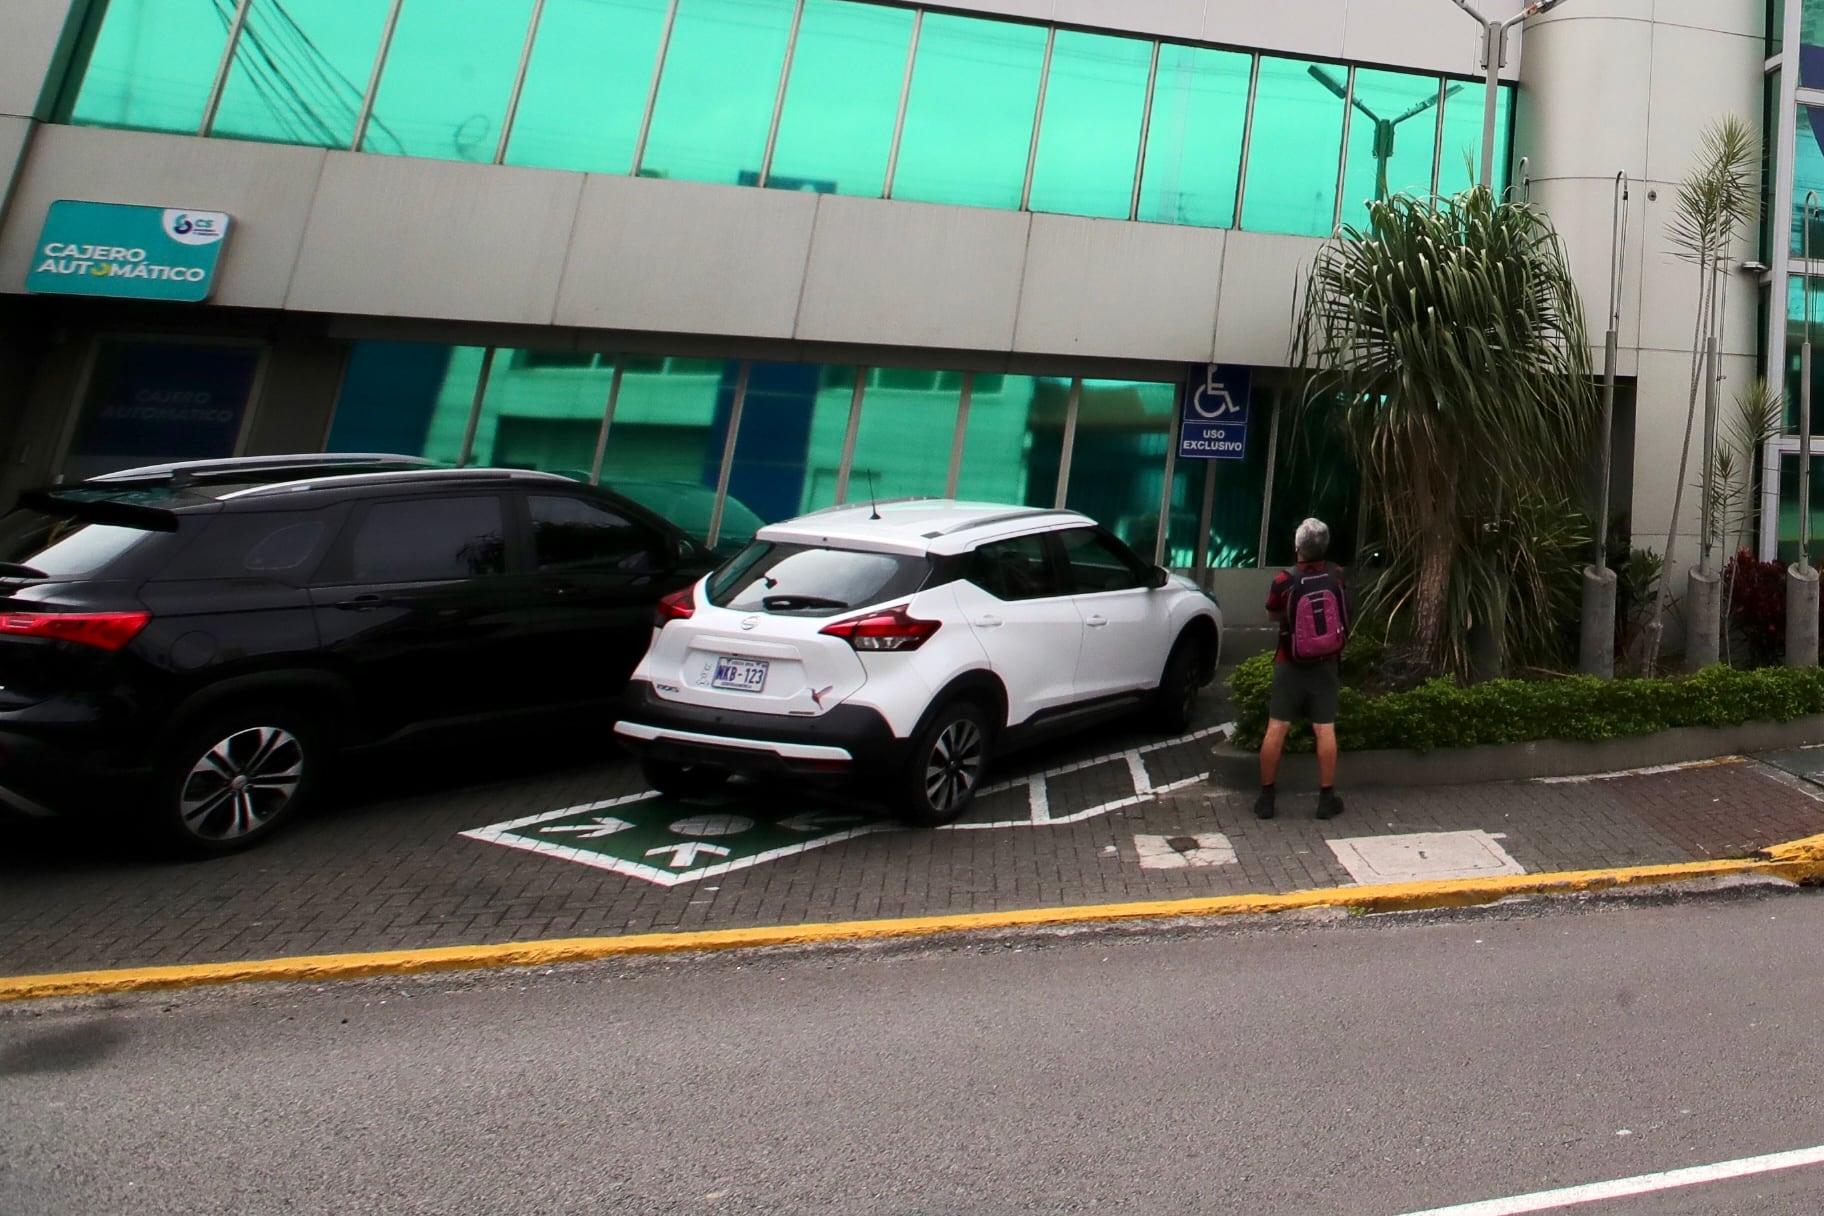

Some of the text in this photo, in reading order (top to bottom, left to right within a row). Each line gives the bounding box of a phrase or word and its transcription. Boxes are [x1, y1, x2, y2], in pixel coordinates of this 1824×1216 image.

[44, 243, 146, 262] CAJERO
[135, 388, 211, 404] CAJERO
[1203, 429, 1225, 439] USO
[1183, 440, 1242, 451] EXCLUSIVO
